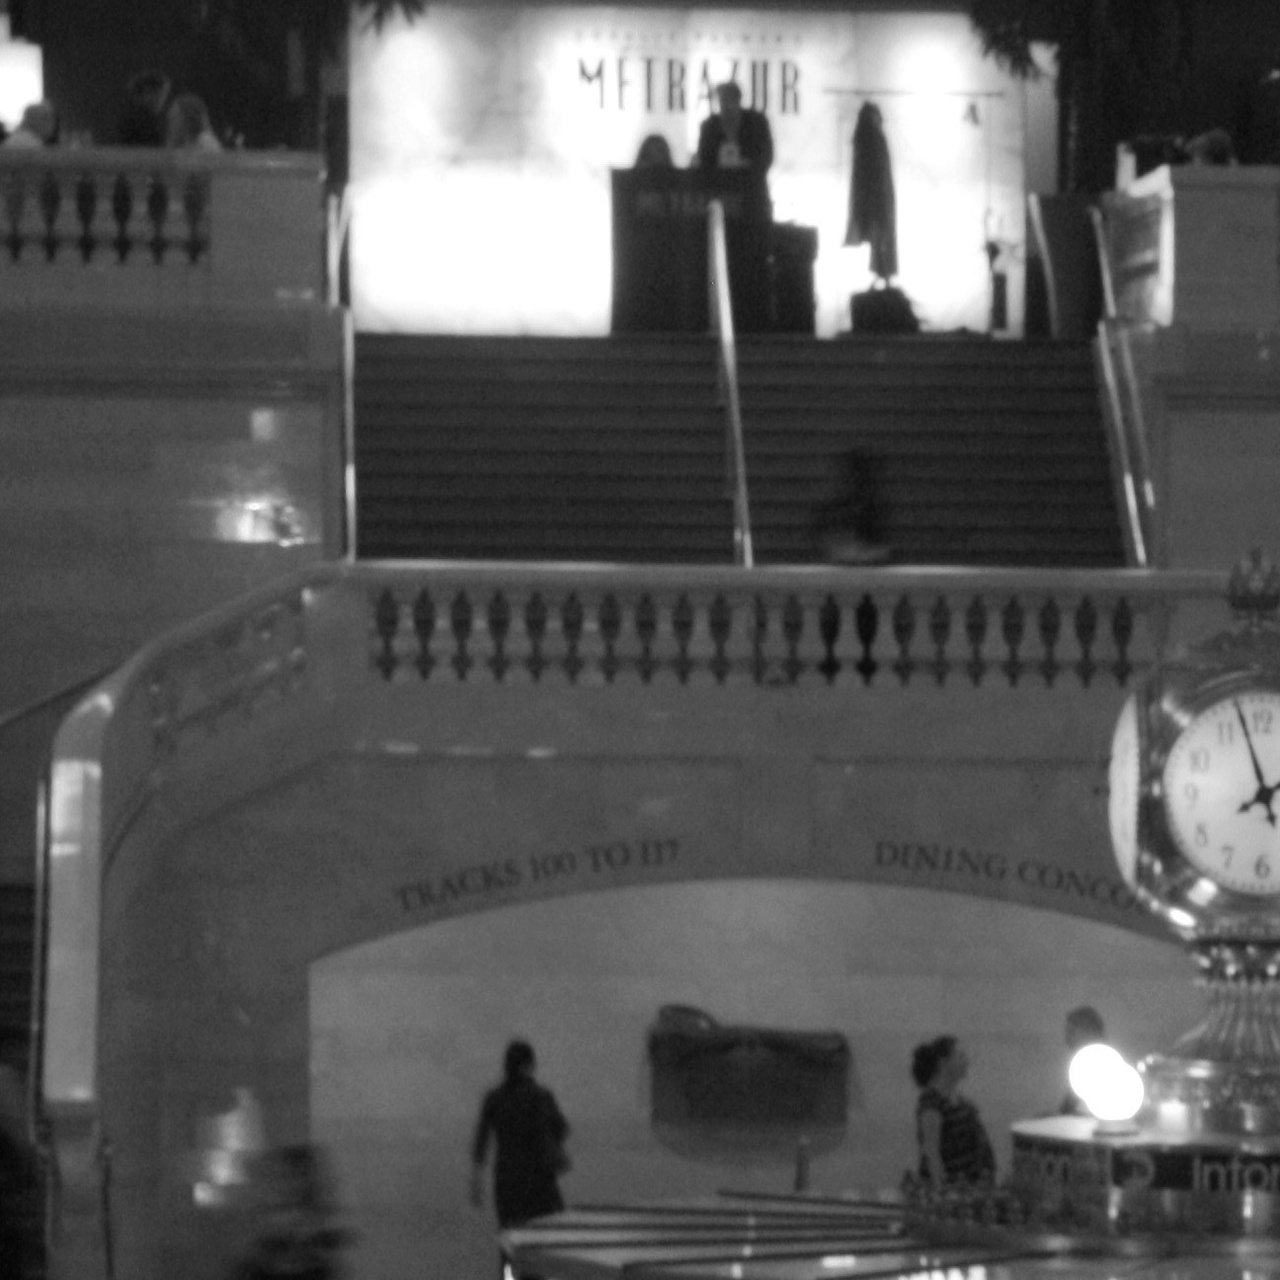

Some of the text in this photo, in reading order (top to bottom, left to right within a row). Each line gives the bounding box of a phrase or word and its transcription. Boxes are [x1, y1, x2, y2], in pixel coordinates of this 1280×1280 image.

[392, 857, 522, 913] TRACKS
[585, 841, 631, 873] TO
[874, 841, 1140, 912] DINING CONCO
